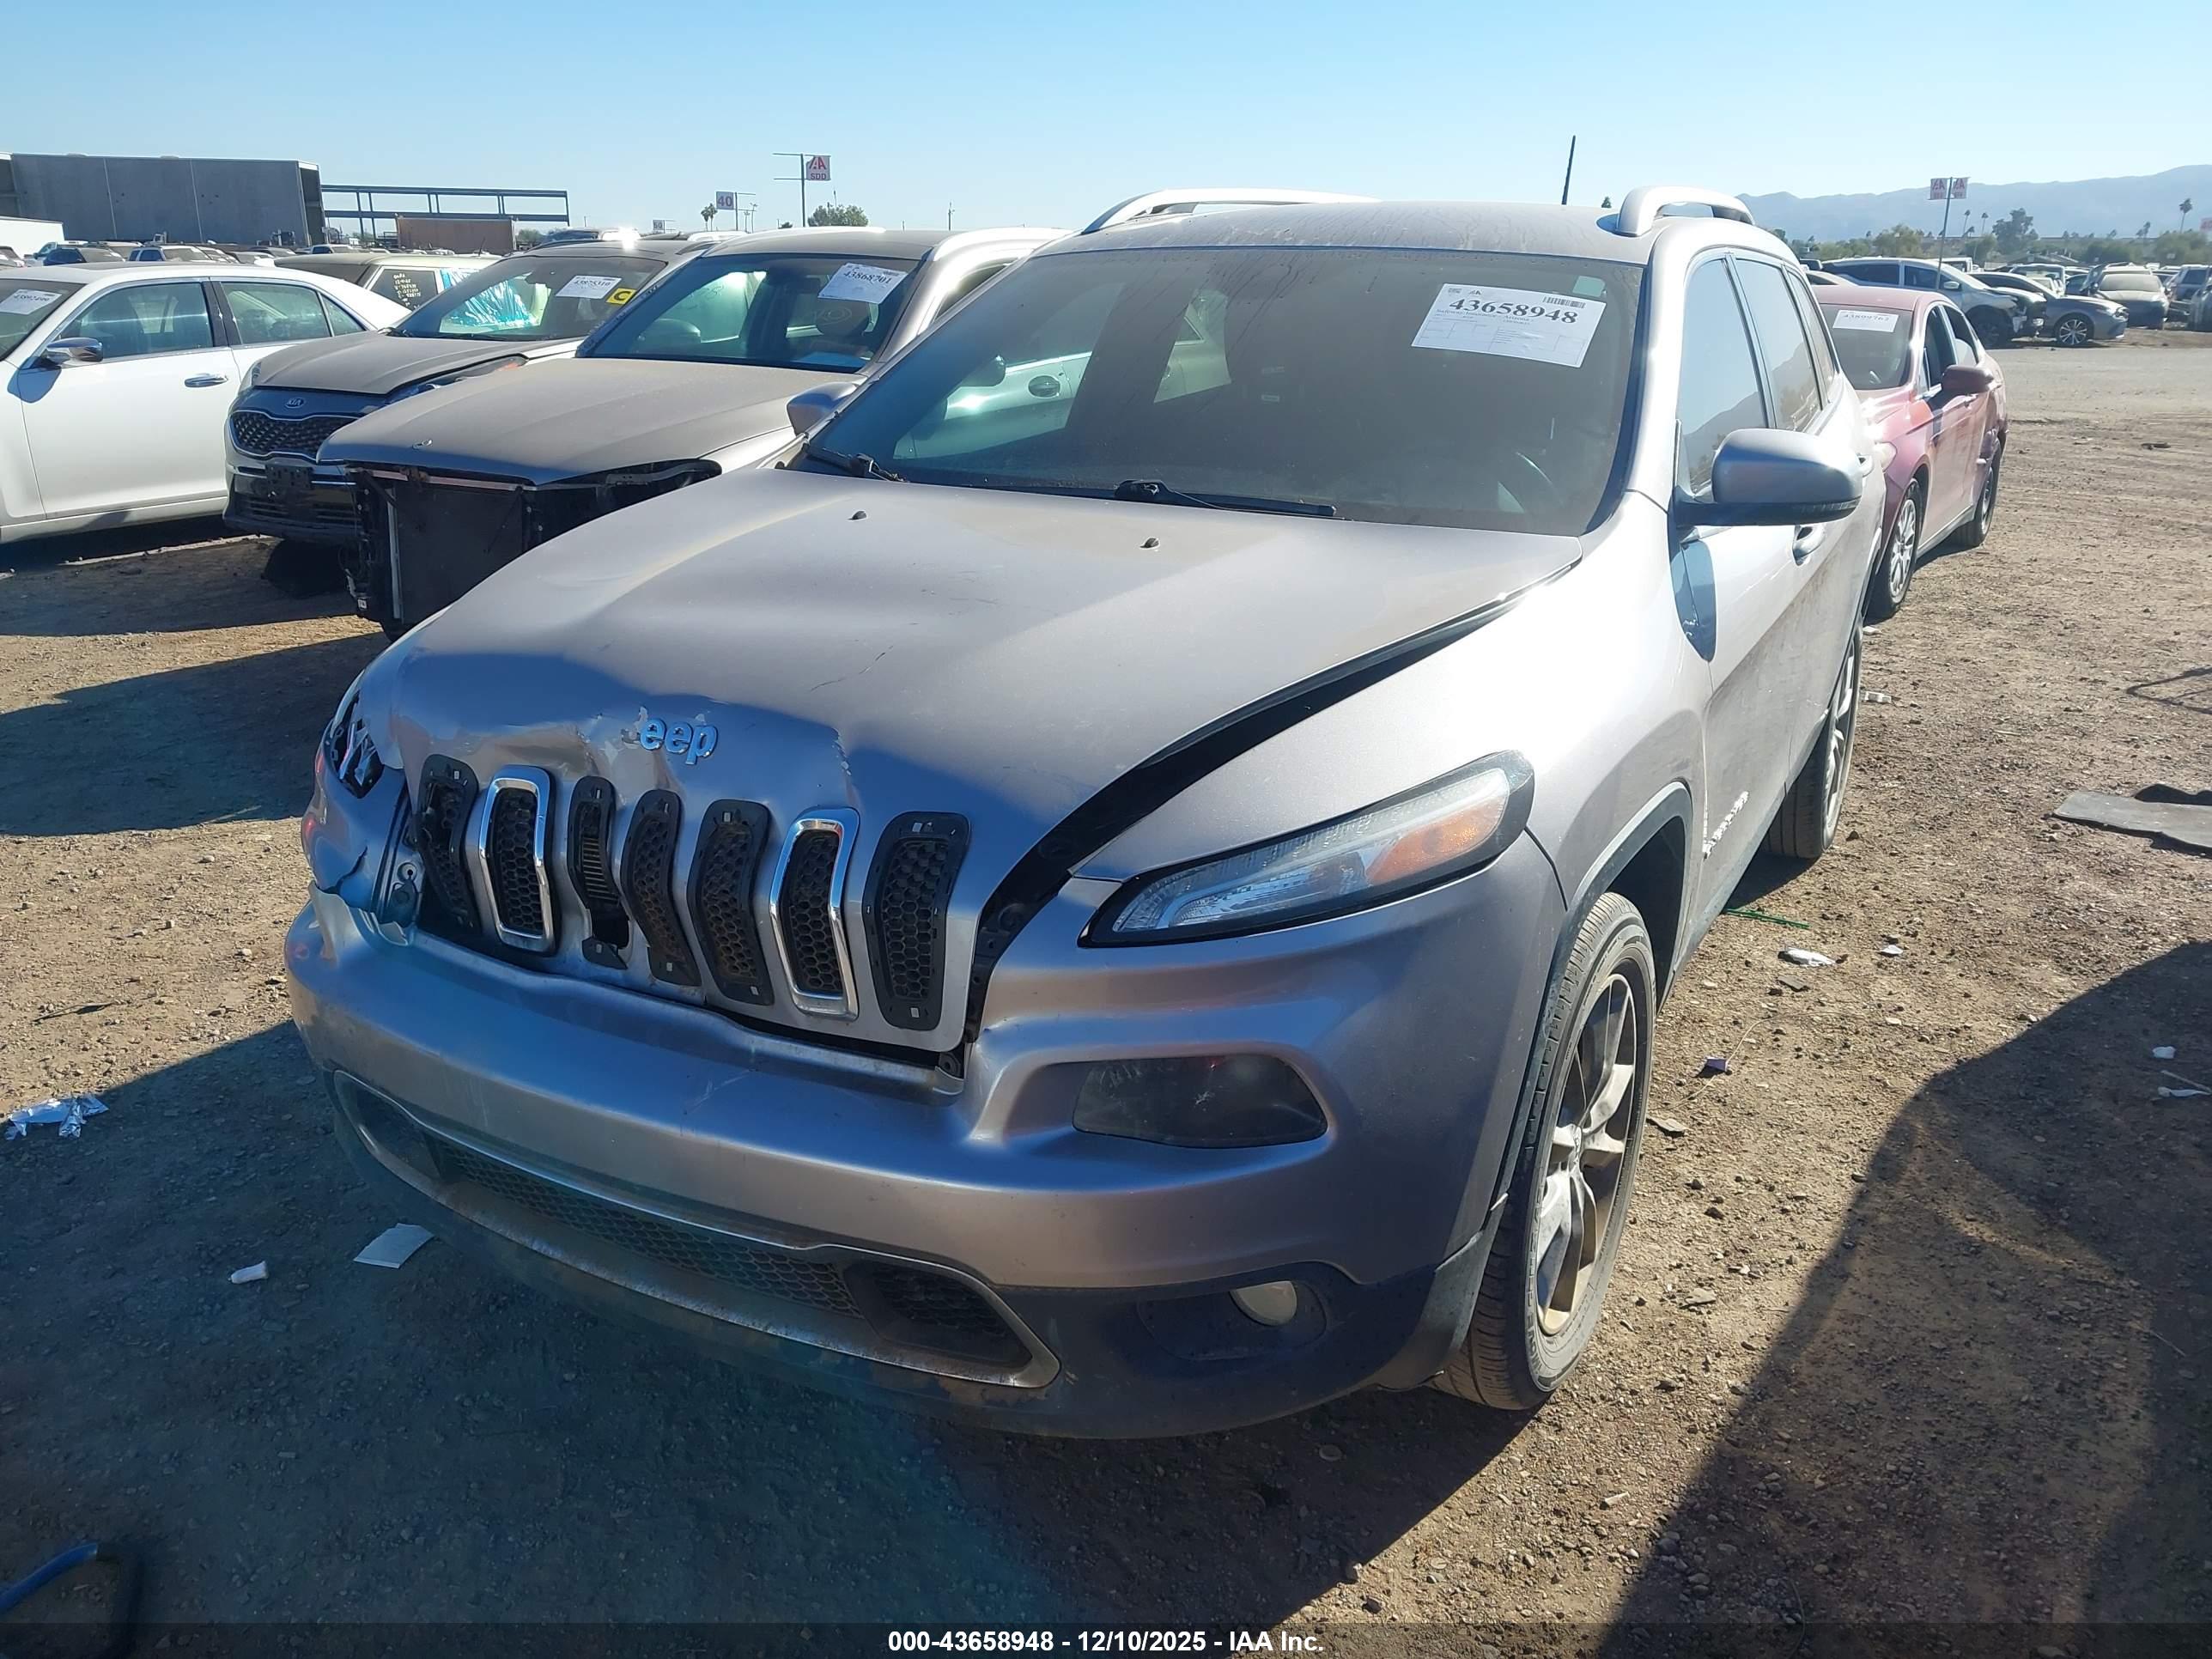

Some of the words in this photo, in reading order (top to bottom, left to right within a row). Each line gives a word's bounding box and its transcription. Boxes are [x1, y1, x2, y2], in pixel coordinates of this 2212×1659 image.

[717, 195, 733, 207] 40
[614, 290, 632, 301] C
[1449, 297, 1578, 324] 43658948
[287, 398, 301, 406] KIA
